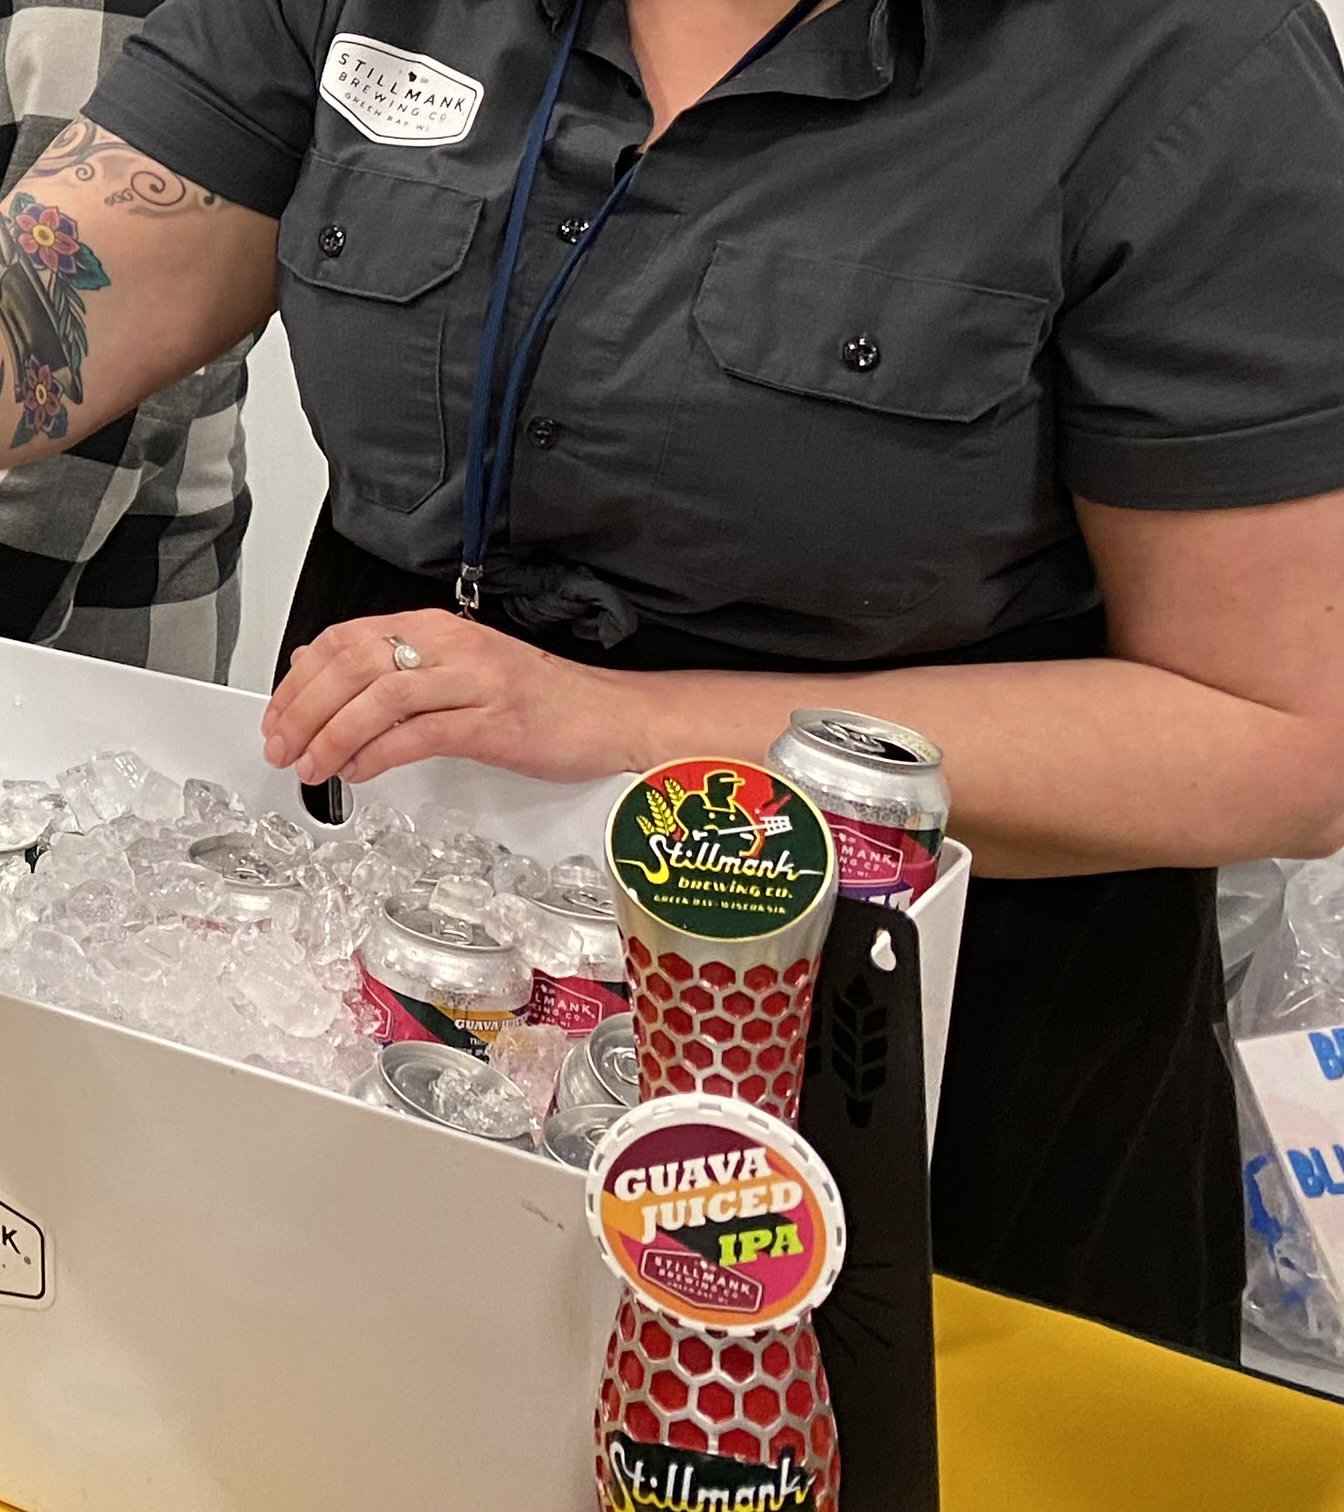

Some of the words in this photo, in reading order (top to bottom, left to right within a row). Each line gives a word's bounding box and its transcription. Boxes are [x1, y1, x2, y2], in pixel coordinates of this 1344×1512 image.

[338, 53, 465, 112] STILLMANK
[338, 71, 420, 116] BREWING
[639, 834, 801, 885] Stillmank
[454, 1019, 499, 1031] GUAVA
[614, 1146, 773, 1202] GUAVA
[640, 1181, 804, 1245] JUICED
[718, 1223, 804, 1267] IPA
[654, 1256, 751, 1295] STILLMANK
[658, 1268, 718, 1292] BREWING
[608, 1441, 817, 1512] Stillmank
